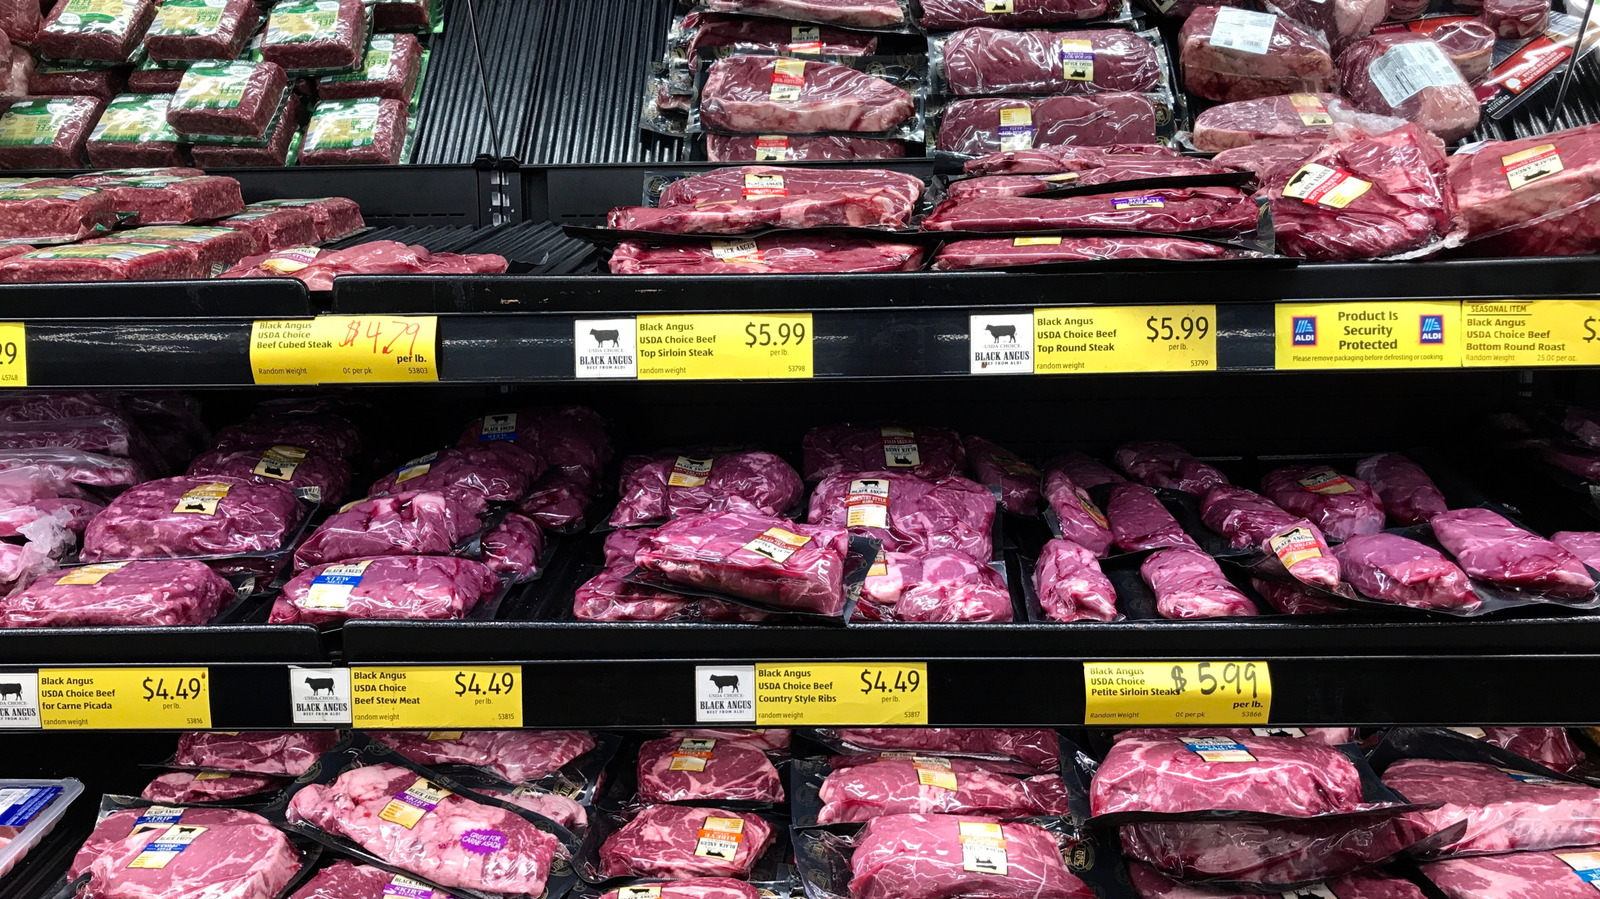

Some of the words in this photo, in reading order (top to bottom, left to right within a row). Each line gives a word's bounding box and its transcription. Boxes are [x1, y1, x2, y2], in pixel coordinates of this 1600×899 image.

[1338, 311, 1385, 321] Product
[1389, 311, 1398, 320] Is
[284, 322, 312, 331] Angus
[1065, 318, 1093, 327] Angus
[1495, 319, 1525, 328] Angus
[666, 323, 694, 332] Angus
[1147, 316, 1208, 342] $5.99
[1344, 324, 1392, 337] Security
[746, 322, 805, 348] $5.99
[1064, 330, 1093, 338] Choice
[1096, 329, 1116, 337] Beef
[1494, 330, 1525, 338] Choice
[1528, 330, 1550, 338] Beef
[665, 335, 694, 343] Choice
[1038, 345, 1054, 354] Top
[1057, 344, 1086, 352] Round
[1089, 343, 1114, 351] Steak
[1339, 339, 1397, 350] Protected
[640, 350, 656, 358] Top
[658, 349, 686, 357] Sirloin
[975, 352, 1000, 361] BLACK
[1004, 351, 1029, 360] ANGUS
[397, 354, 412, 364] per
[580, 356, 605, 365] BLACK
[608, 356, 632, 365] ANGUS
[1063, 362, 1084, 370] weight
[285, 368, 307, 376] Weight
[665, 367, 686, 375] weight
[354, 671, 377, 679] Black
[380, 672, 406, 681] Angus
[784, 670, 811, 679] Angus
[1116, 668, 1144, 676] Angus
[66, 678, 93, 686] Angus
[455, 672, 513, 697] $4.49
[861, 669, 919, 694] $4.49
[1116, 677, 1145, 685] Choice
[1171, 663, 1258, 698] $5.99
[143, 677, 200, 702] $4.49
[759, 695, 792, 704] Country
[795, 695, 816, 704] Style
[700, 701, 724, 709] BLACK
[728, 701, 751, 709] ANGUS
[11, 708, 36, 716] ANGUS
[783, 712, 803, 720] weight
[404, 793, 428, 808] SKIRT
[470, 832, 489, 841] GREAT
[705, 833, 736, 842] RIBEYE
[462, 836, 484, 847] CARNE
[484, 839, 501, 850] ASADA
